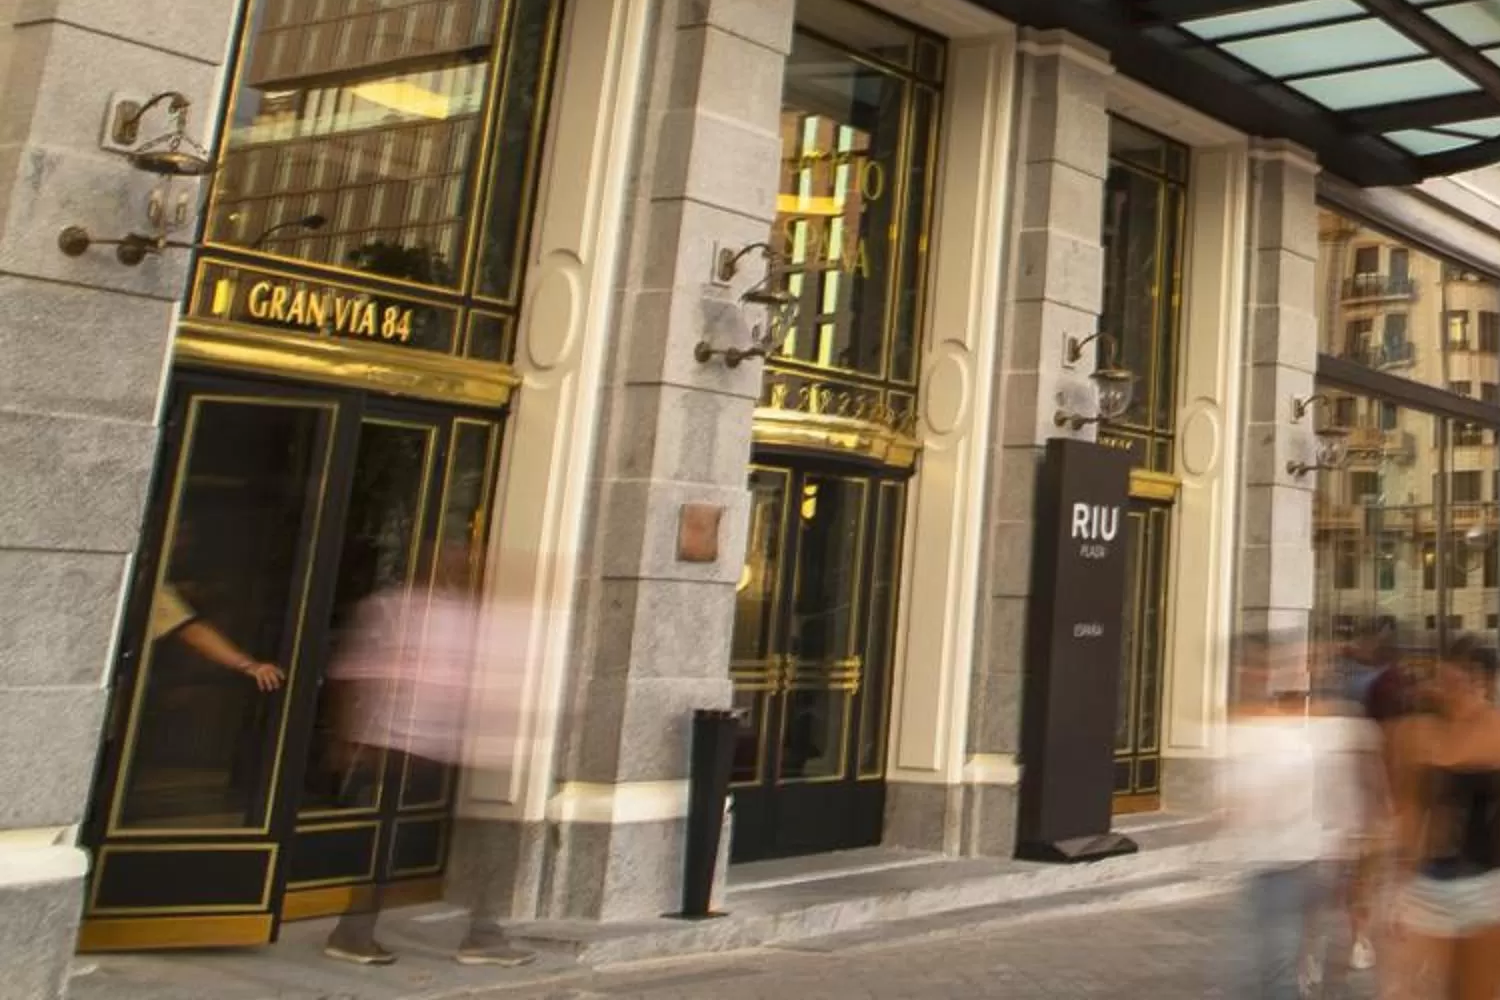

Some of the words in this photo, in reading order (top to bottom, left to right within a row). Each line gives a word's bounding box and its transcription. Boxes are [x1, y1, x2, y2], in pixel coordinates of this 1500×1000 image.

[249, 279, 327, 328] GRAN
[381, 304, 414, 342] 84
[1071, 502, 1120, 541] RIU
